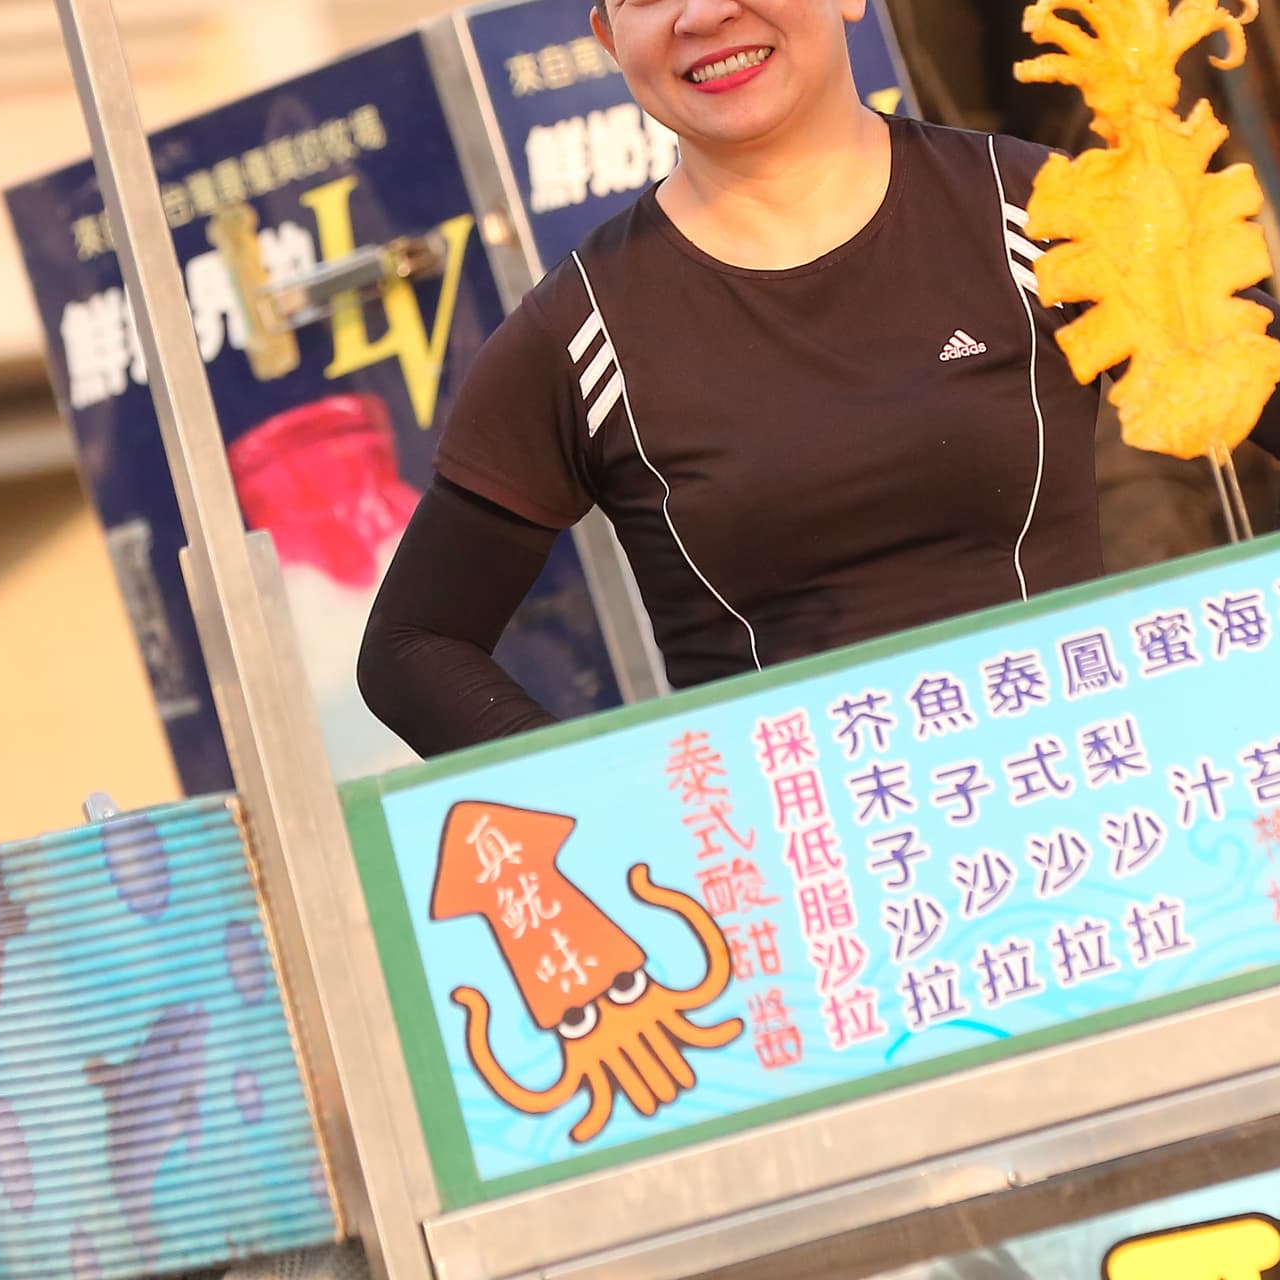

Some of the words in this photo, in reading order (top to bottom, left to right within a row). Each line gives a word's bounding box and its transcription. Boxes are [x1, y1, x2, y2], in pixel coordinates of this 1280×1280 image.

[939, 342, 987, 361] adidas
[753, 711, 885, 1050] 採用低脂沙拉
